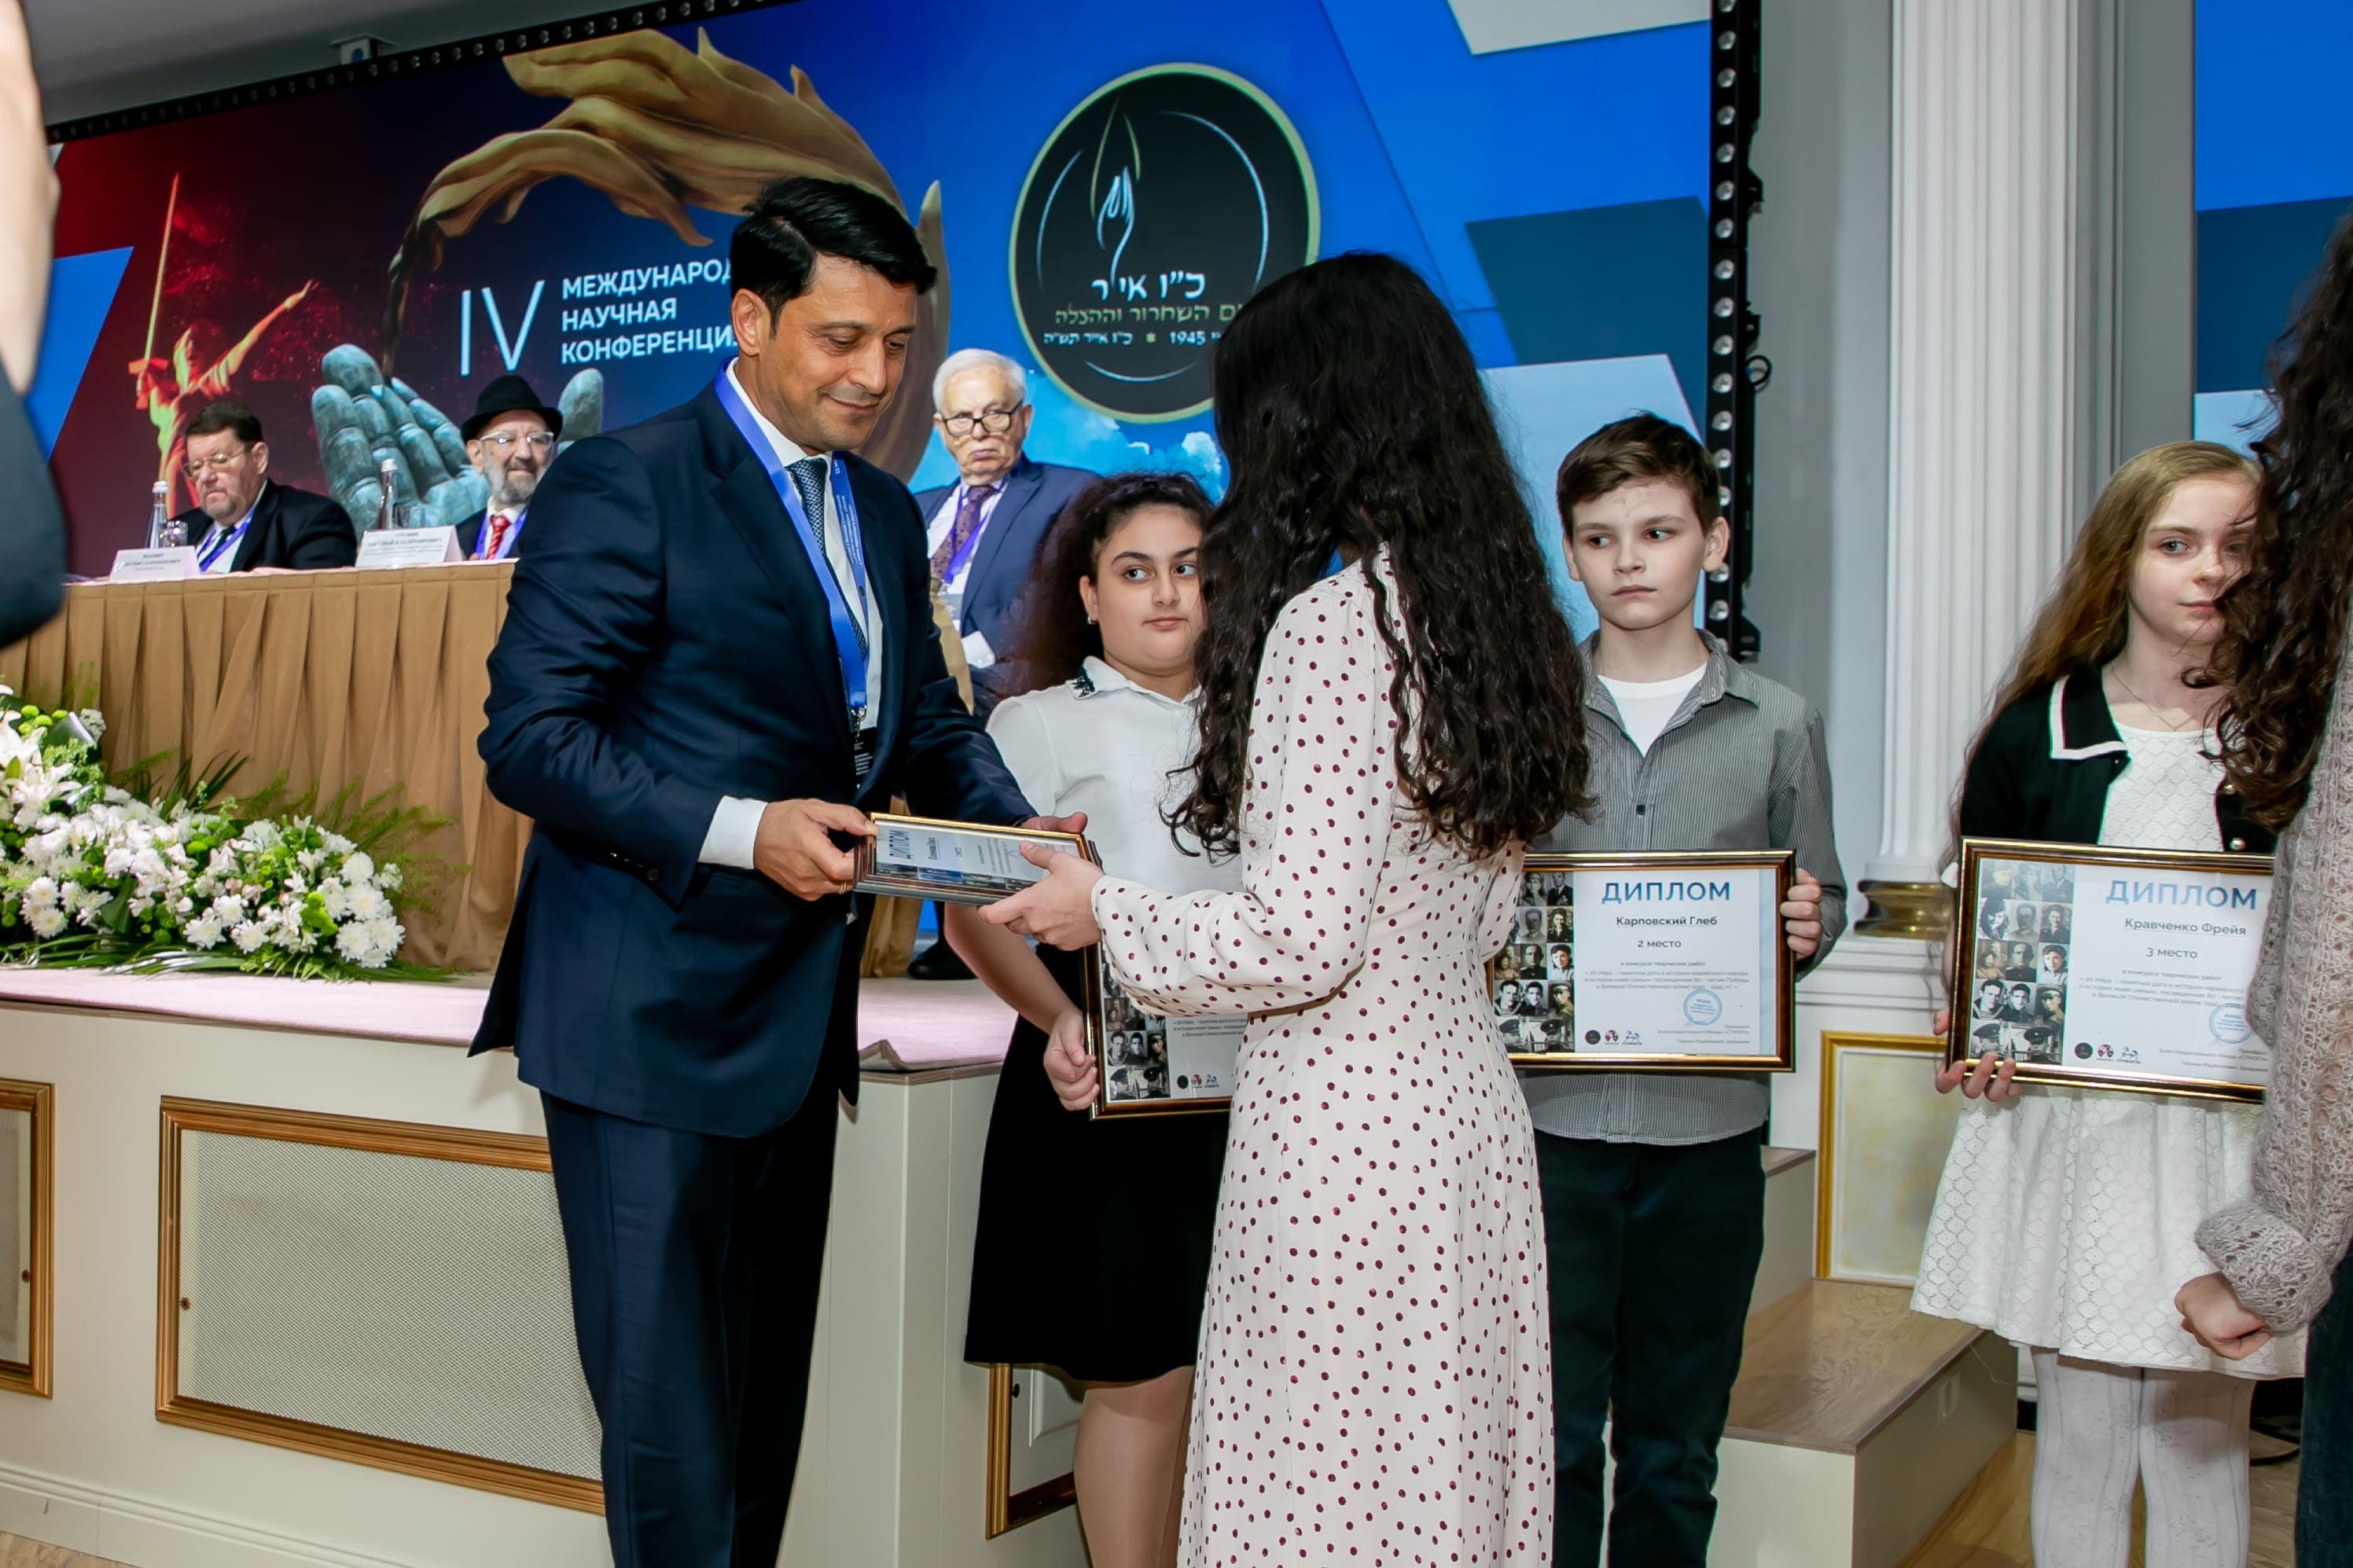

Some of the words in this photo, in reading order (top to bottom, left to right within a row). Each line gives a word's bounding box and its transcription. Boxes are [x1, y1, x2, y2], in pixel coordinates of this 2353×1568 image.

[561, 297, 677, 332] НАУЧНАЯ
[1055, 302, 1123, 325] וההצלה
[1128, 305, 1210, 323] השחרור
[461, 280, 545, 376] IV
[1169, 330, 1207, 346] 1945
[561, 325, 738, 365] КОНФЕРЕНЦИ
[1601, 882, 1730, 905] ДИПЛОМ
[2105, 879, 2258, 910] ДИПЛОМ
[1616, 916, 1686, 927] Карповский
[1689, 916, 1718, 926] Глеб
[2125, 917, 2198, 932] Кравченко
[2201, 923, 2246, 936] Фрейя
[2146, 947, 2154, 957] 3
[2157, 948, 2198, 959] место
